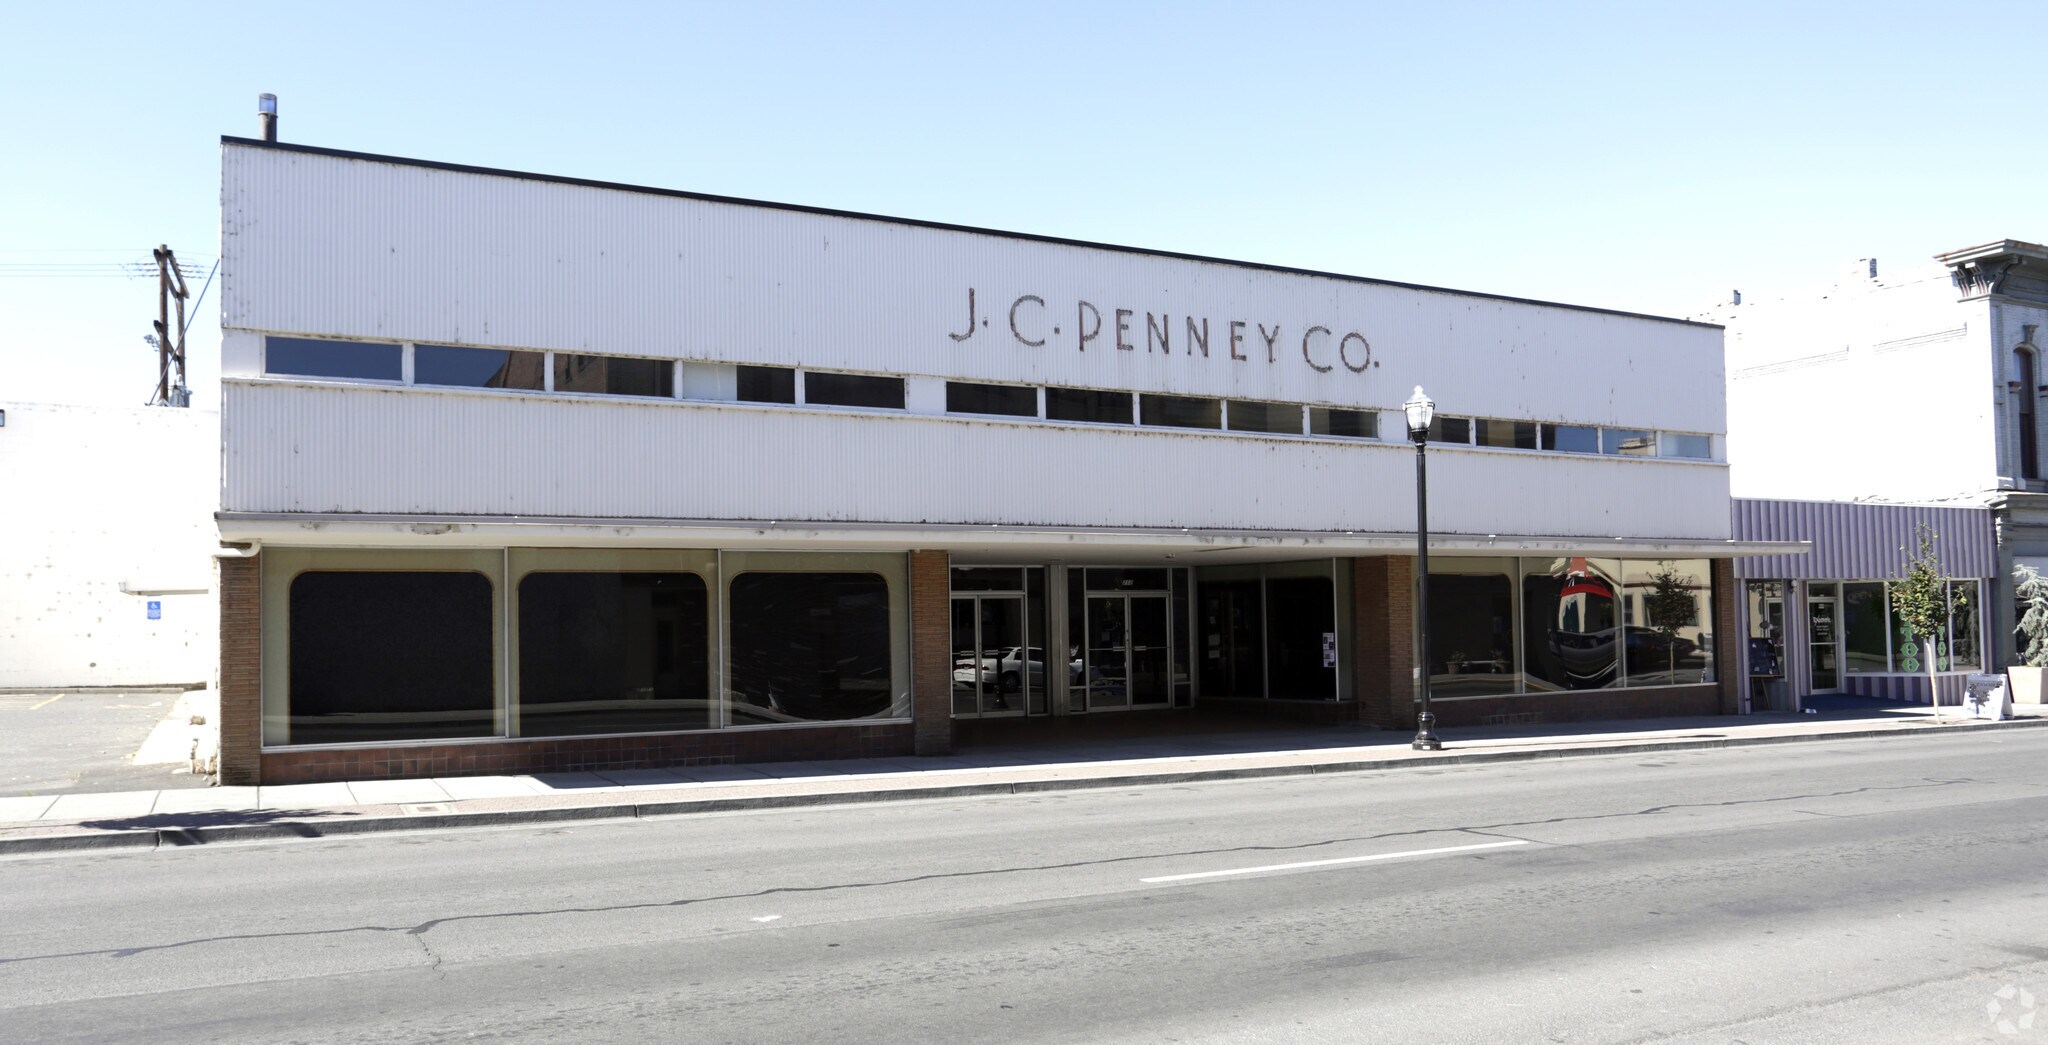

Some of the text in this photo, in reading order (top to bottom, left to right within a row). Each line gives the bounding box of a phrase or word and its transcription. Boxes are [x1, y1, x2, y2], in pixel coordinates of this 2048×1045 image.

[1077, 299, 1281, 366] PENNEY
[1302, 325, 1380, 375] CO.
[1847, 590, 1872, 604] OPEN
